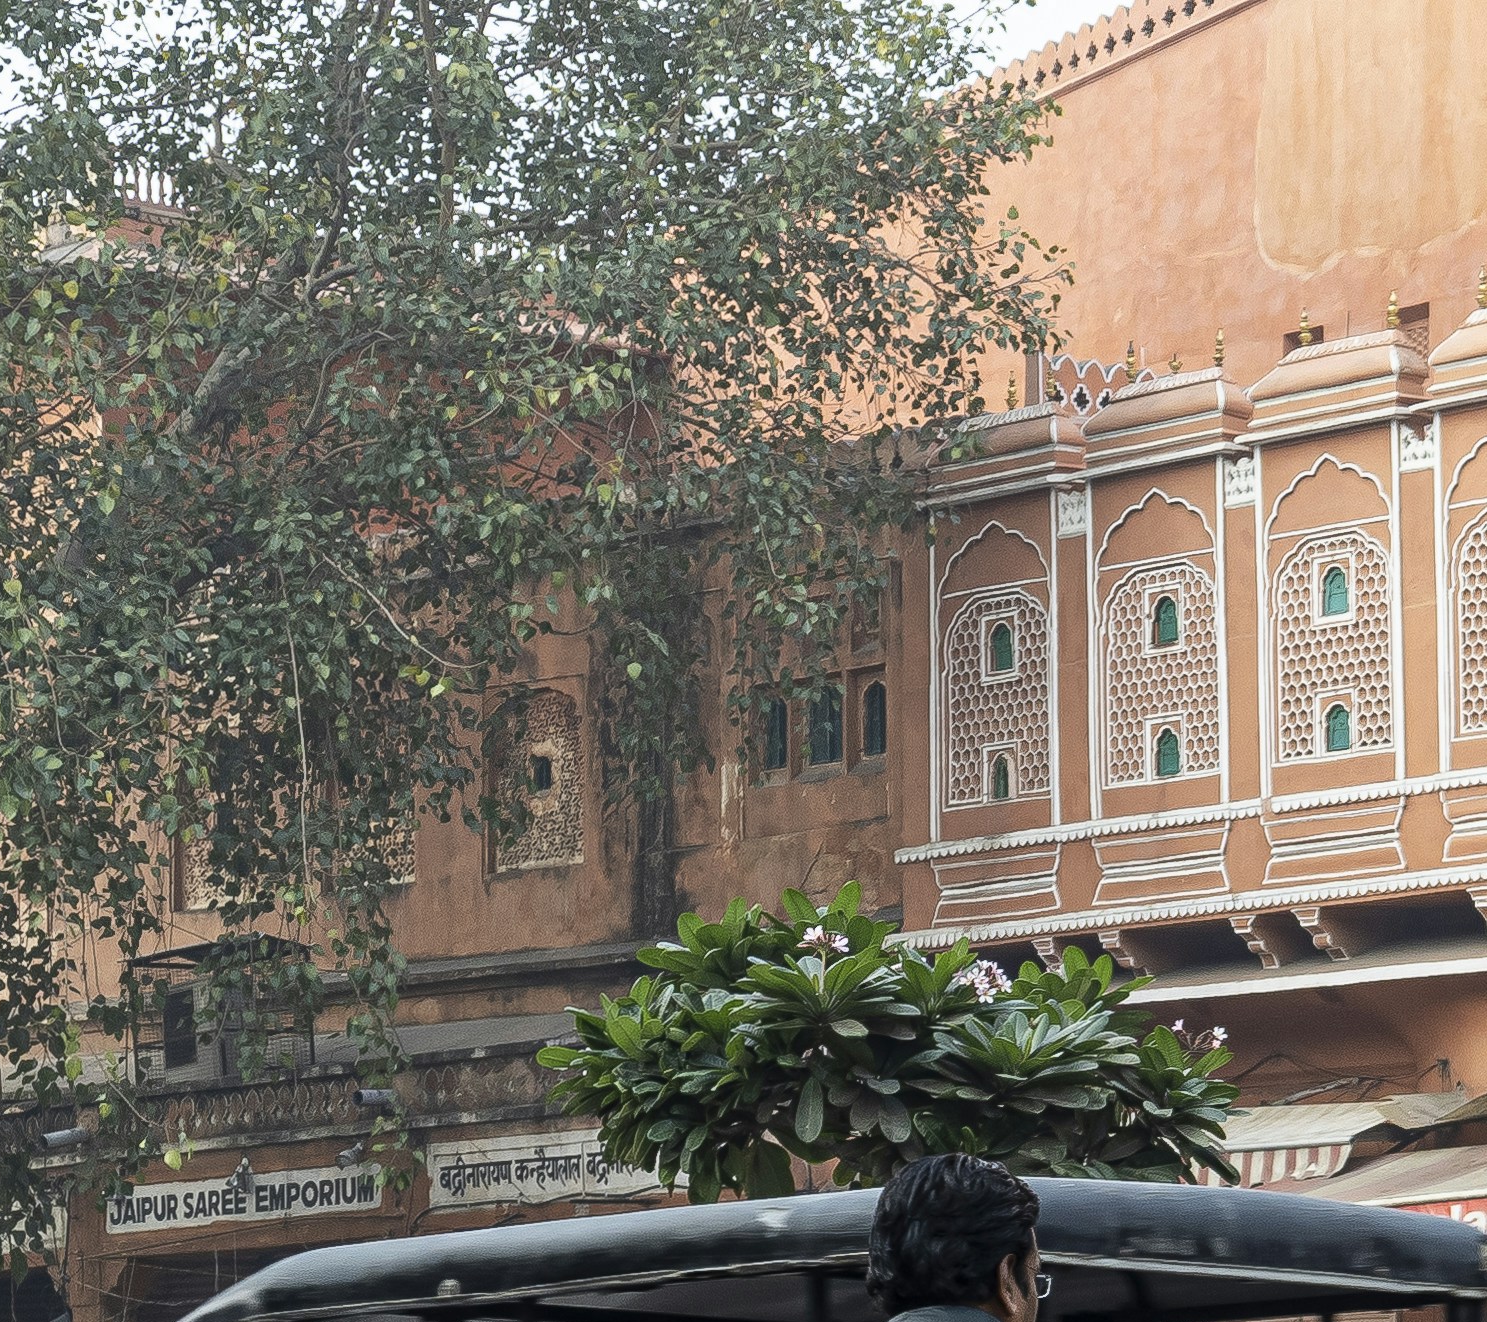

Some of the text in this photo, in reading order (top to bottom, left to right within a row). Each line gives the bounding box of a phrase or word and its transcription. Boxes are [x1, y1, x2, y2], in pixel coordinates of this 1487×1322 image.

[110, 1174, 375, 1226] JAIPUR SAREE EMPORIUM
